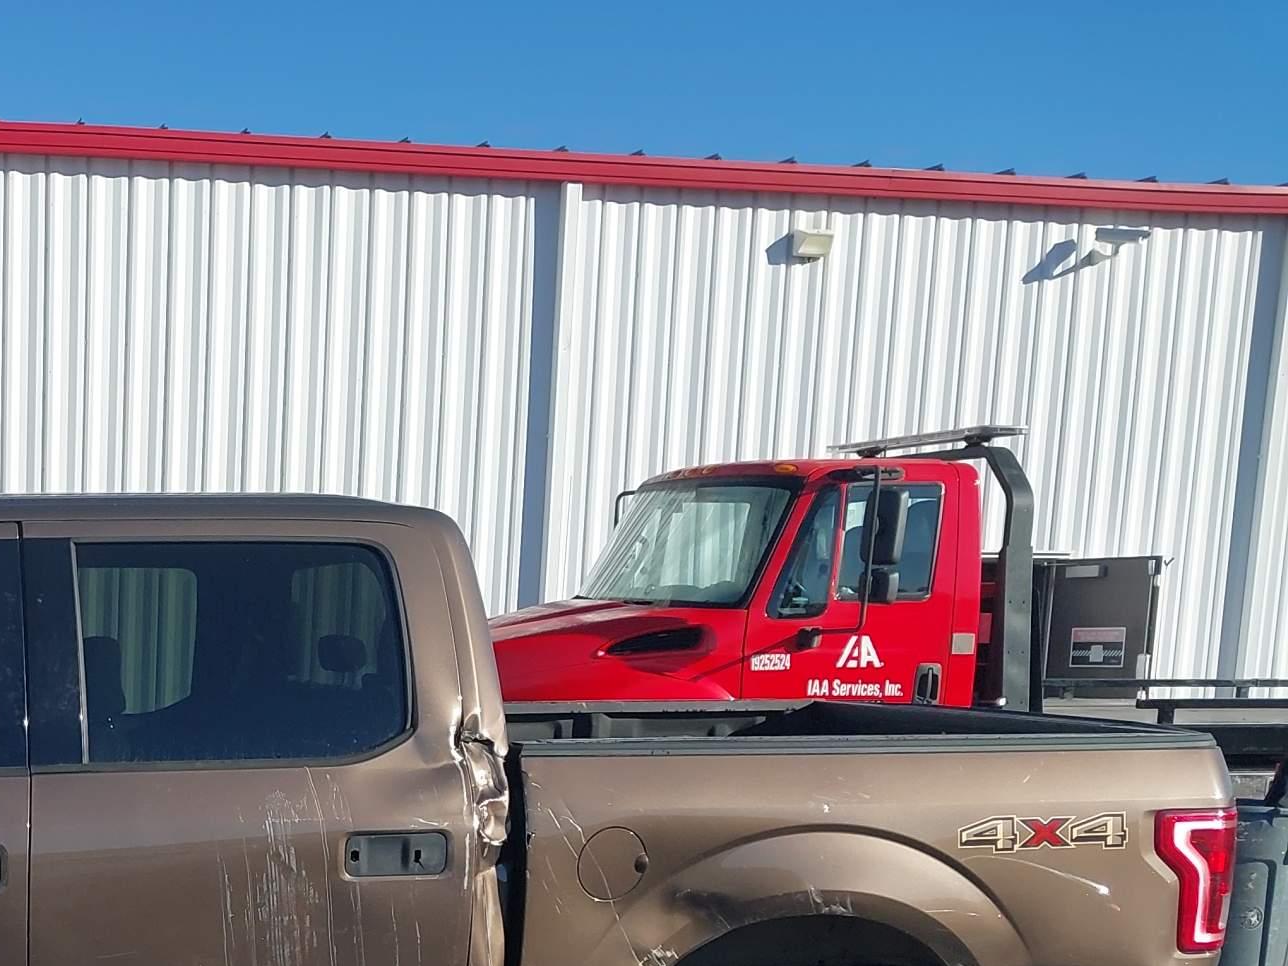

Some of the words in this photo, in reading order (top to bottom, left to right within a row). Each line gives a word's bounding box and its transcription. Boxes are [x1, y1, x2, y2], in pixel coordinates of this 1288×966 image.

[750, 653, 791, 671] 19252524
[807, 679, 829, 696] IAA
[831, 679, 882, 698] Services,
[884, 679, 903, 697] Inc.
